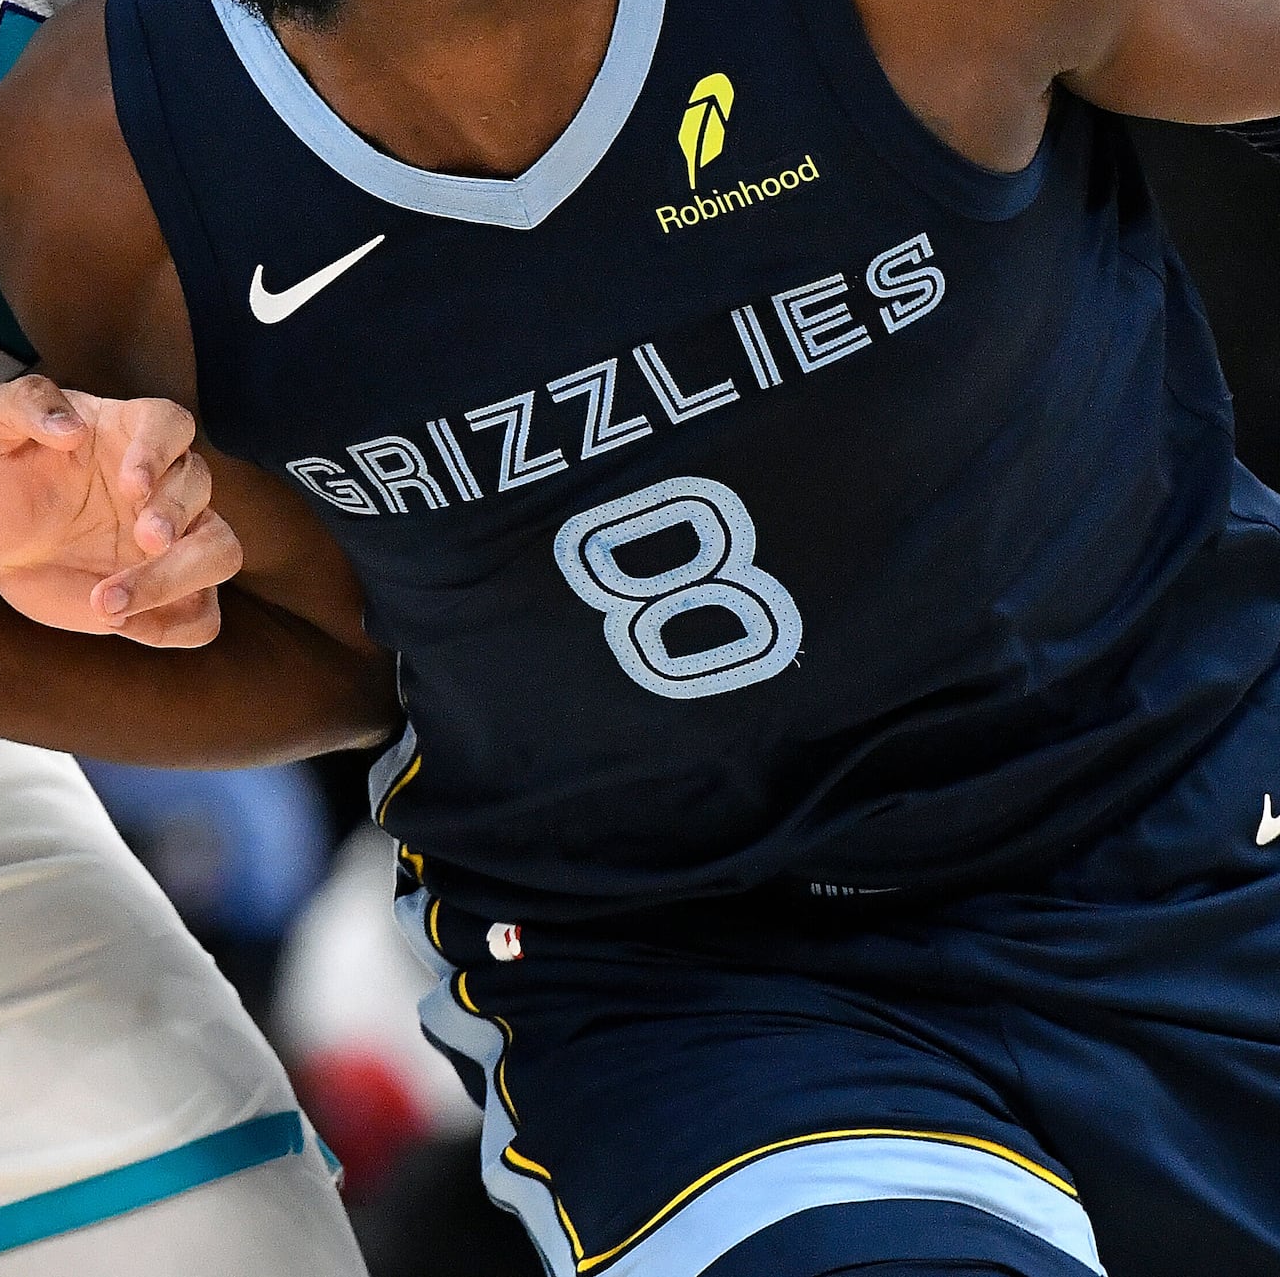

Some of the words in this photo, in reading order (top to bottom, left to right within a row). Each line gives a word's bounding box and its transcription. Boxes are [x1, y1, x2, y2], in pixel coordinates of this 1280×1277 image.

[655, 154, 820, 234] Robinhood
[286, 232, 946, 515] GRIZZLIES
[553, 476, 803, 699] 8
